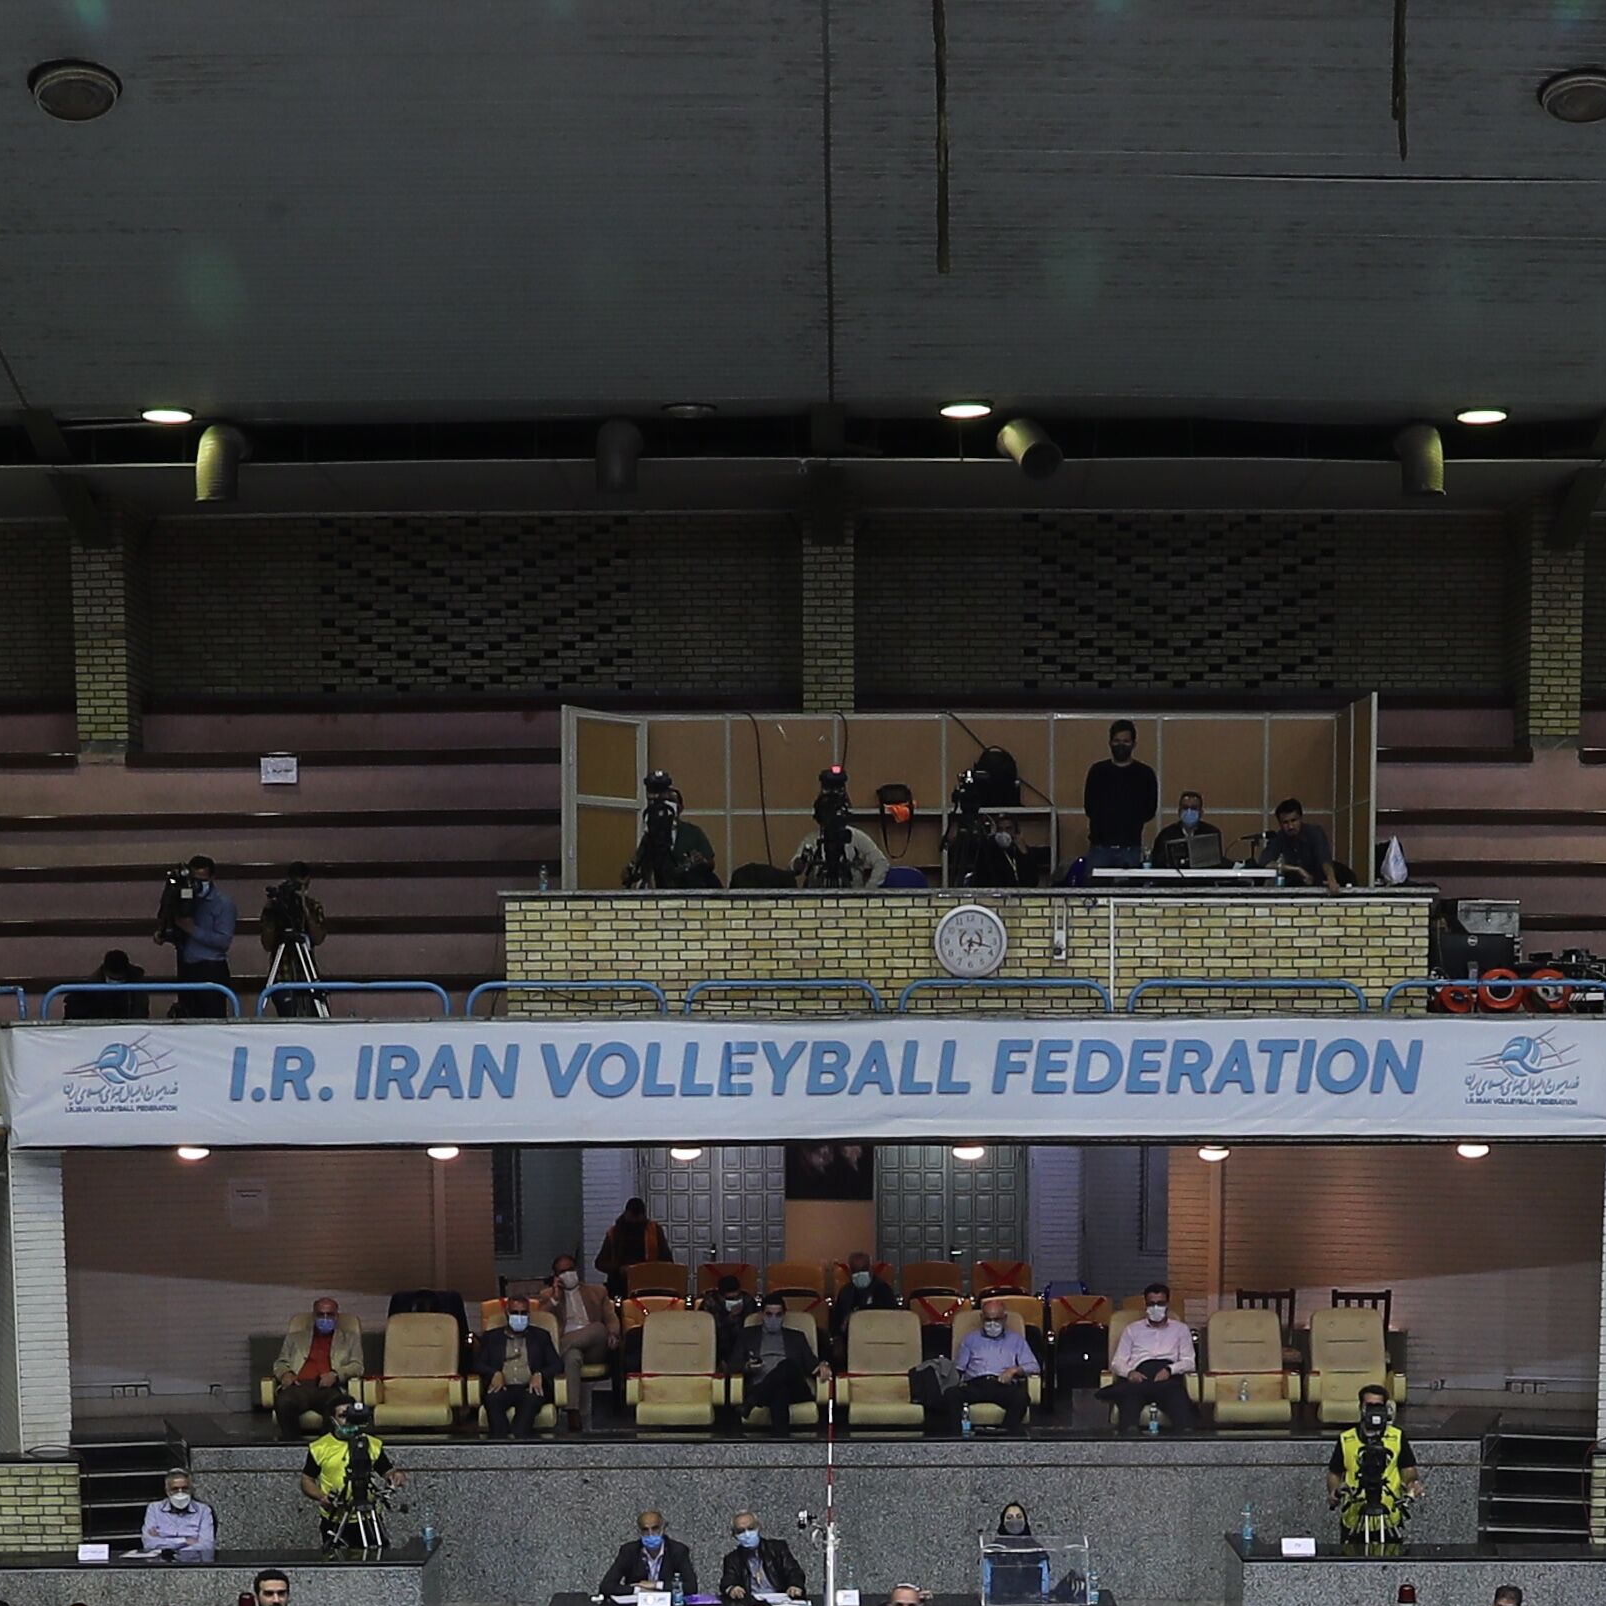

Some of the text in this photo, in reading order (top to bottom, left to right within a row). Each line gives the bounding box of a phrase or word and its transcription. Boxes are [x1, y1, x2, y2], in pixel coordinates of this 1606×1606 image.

[956, 917, 963, 926] 11
[966, 914, 975, 922] 12
[229, 1038, 1424, 1101] I.R. IRAN VOLLEYBALL FEDERATION
